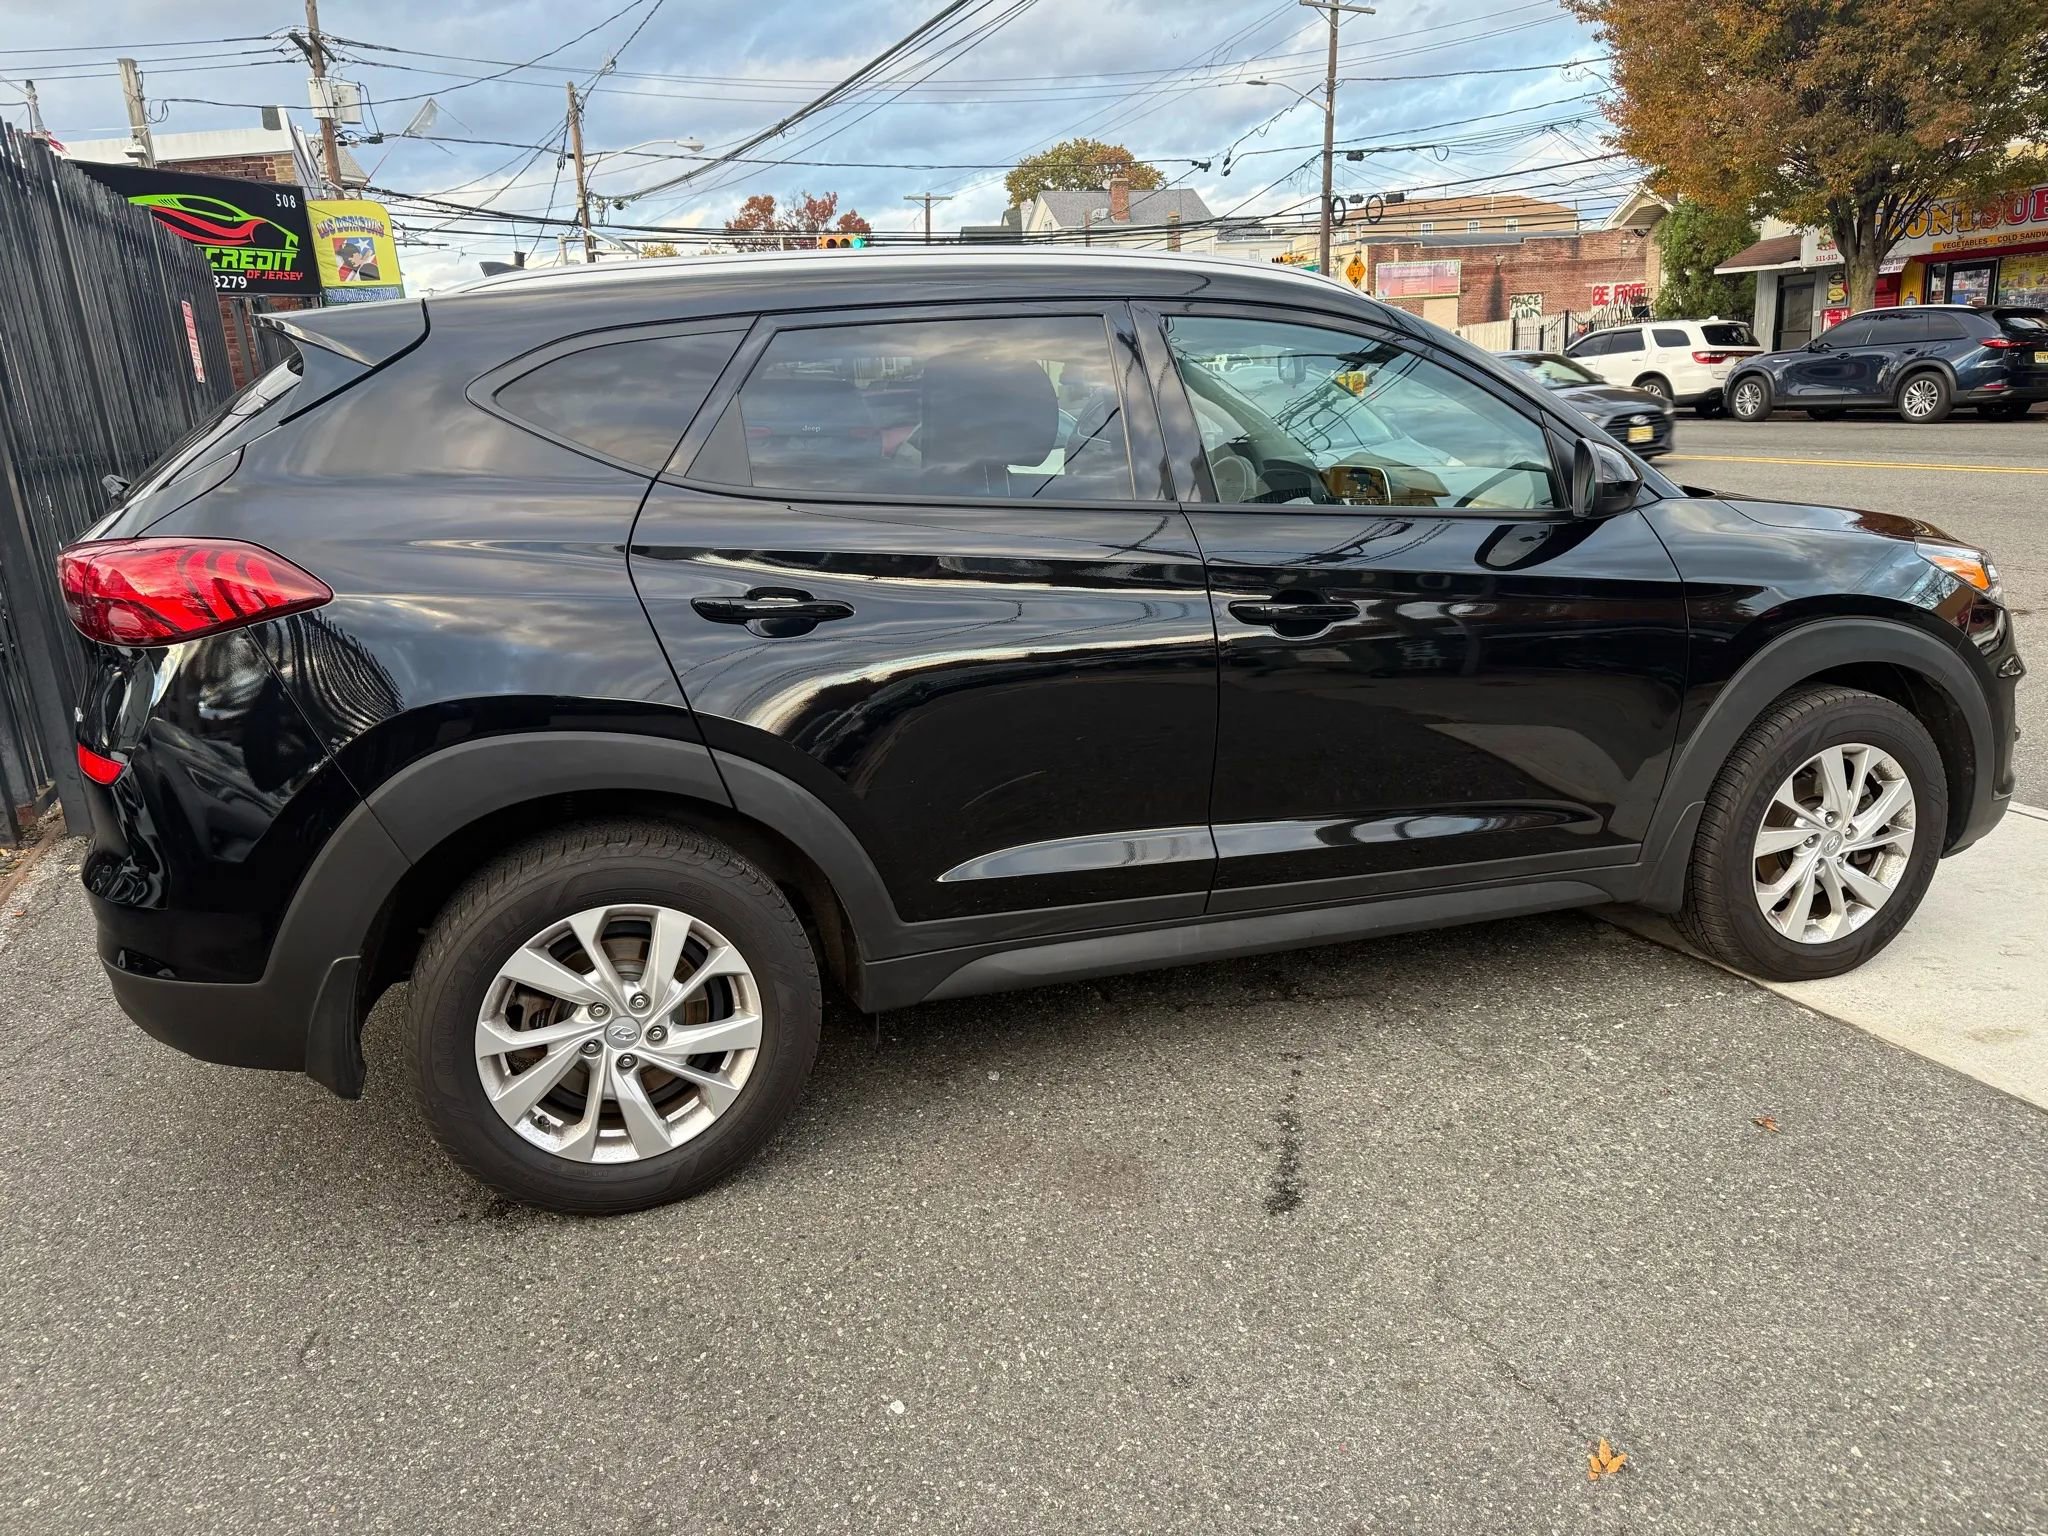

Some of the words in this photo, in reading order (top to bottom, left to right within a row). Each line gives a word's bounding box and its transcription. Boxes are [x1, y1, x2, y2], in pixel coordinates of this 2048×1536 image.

[275, 193, 297, 208] 508
[1942, 237, 1988, 249] VEGETABLES
[1997, 233, 2018, 243] COLD
[205, 247, 298, 272] CREDIT
[1815, 253, 1838, 262] 511-513
[246, 270, 261, 279] OF
[262, 271, 304, 281] JERSEY
[1593, 286, 1609, 306] BE
[801, 424, 821, 433] Jeep
